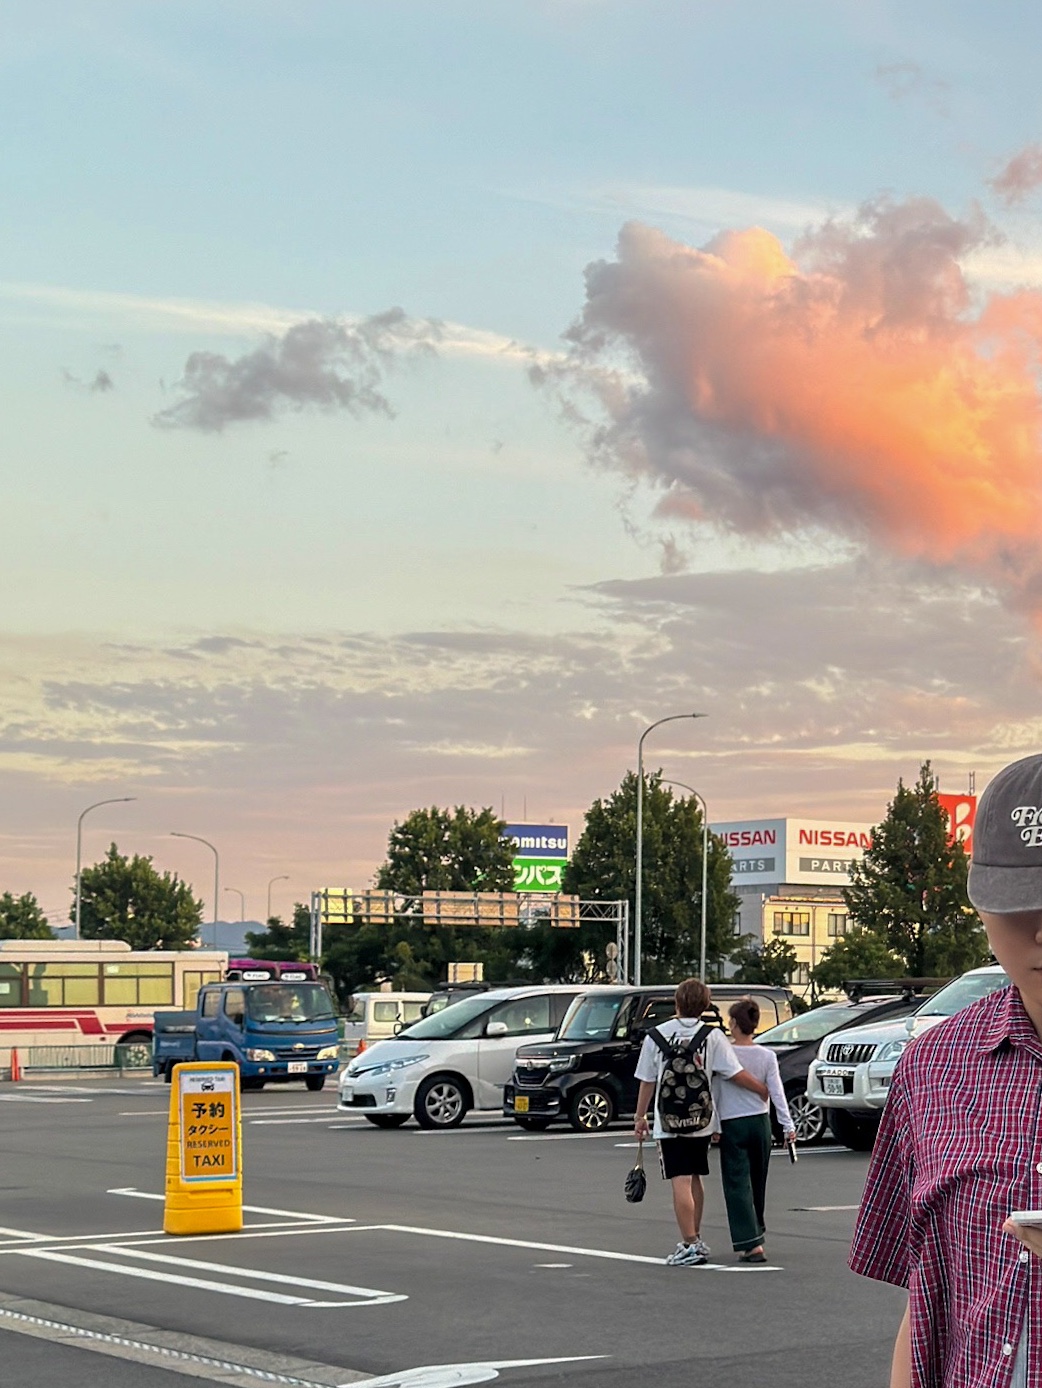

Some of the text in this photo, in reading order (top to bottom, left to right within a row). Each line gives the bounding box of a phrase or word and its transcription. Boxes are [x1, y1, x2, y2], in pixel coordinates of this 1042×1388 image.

[191, 1101, 225, 1119] 予約
[188, 1124, 229, 1136] タクシー
[187, 1140, 231, 1149] RESERVED
[193, 1154, 225, 1168] TAXI
